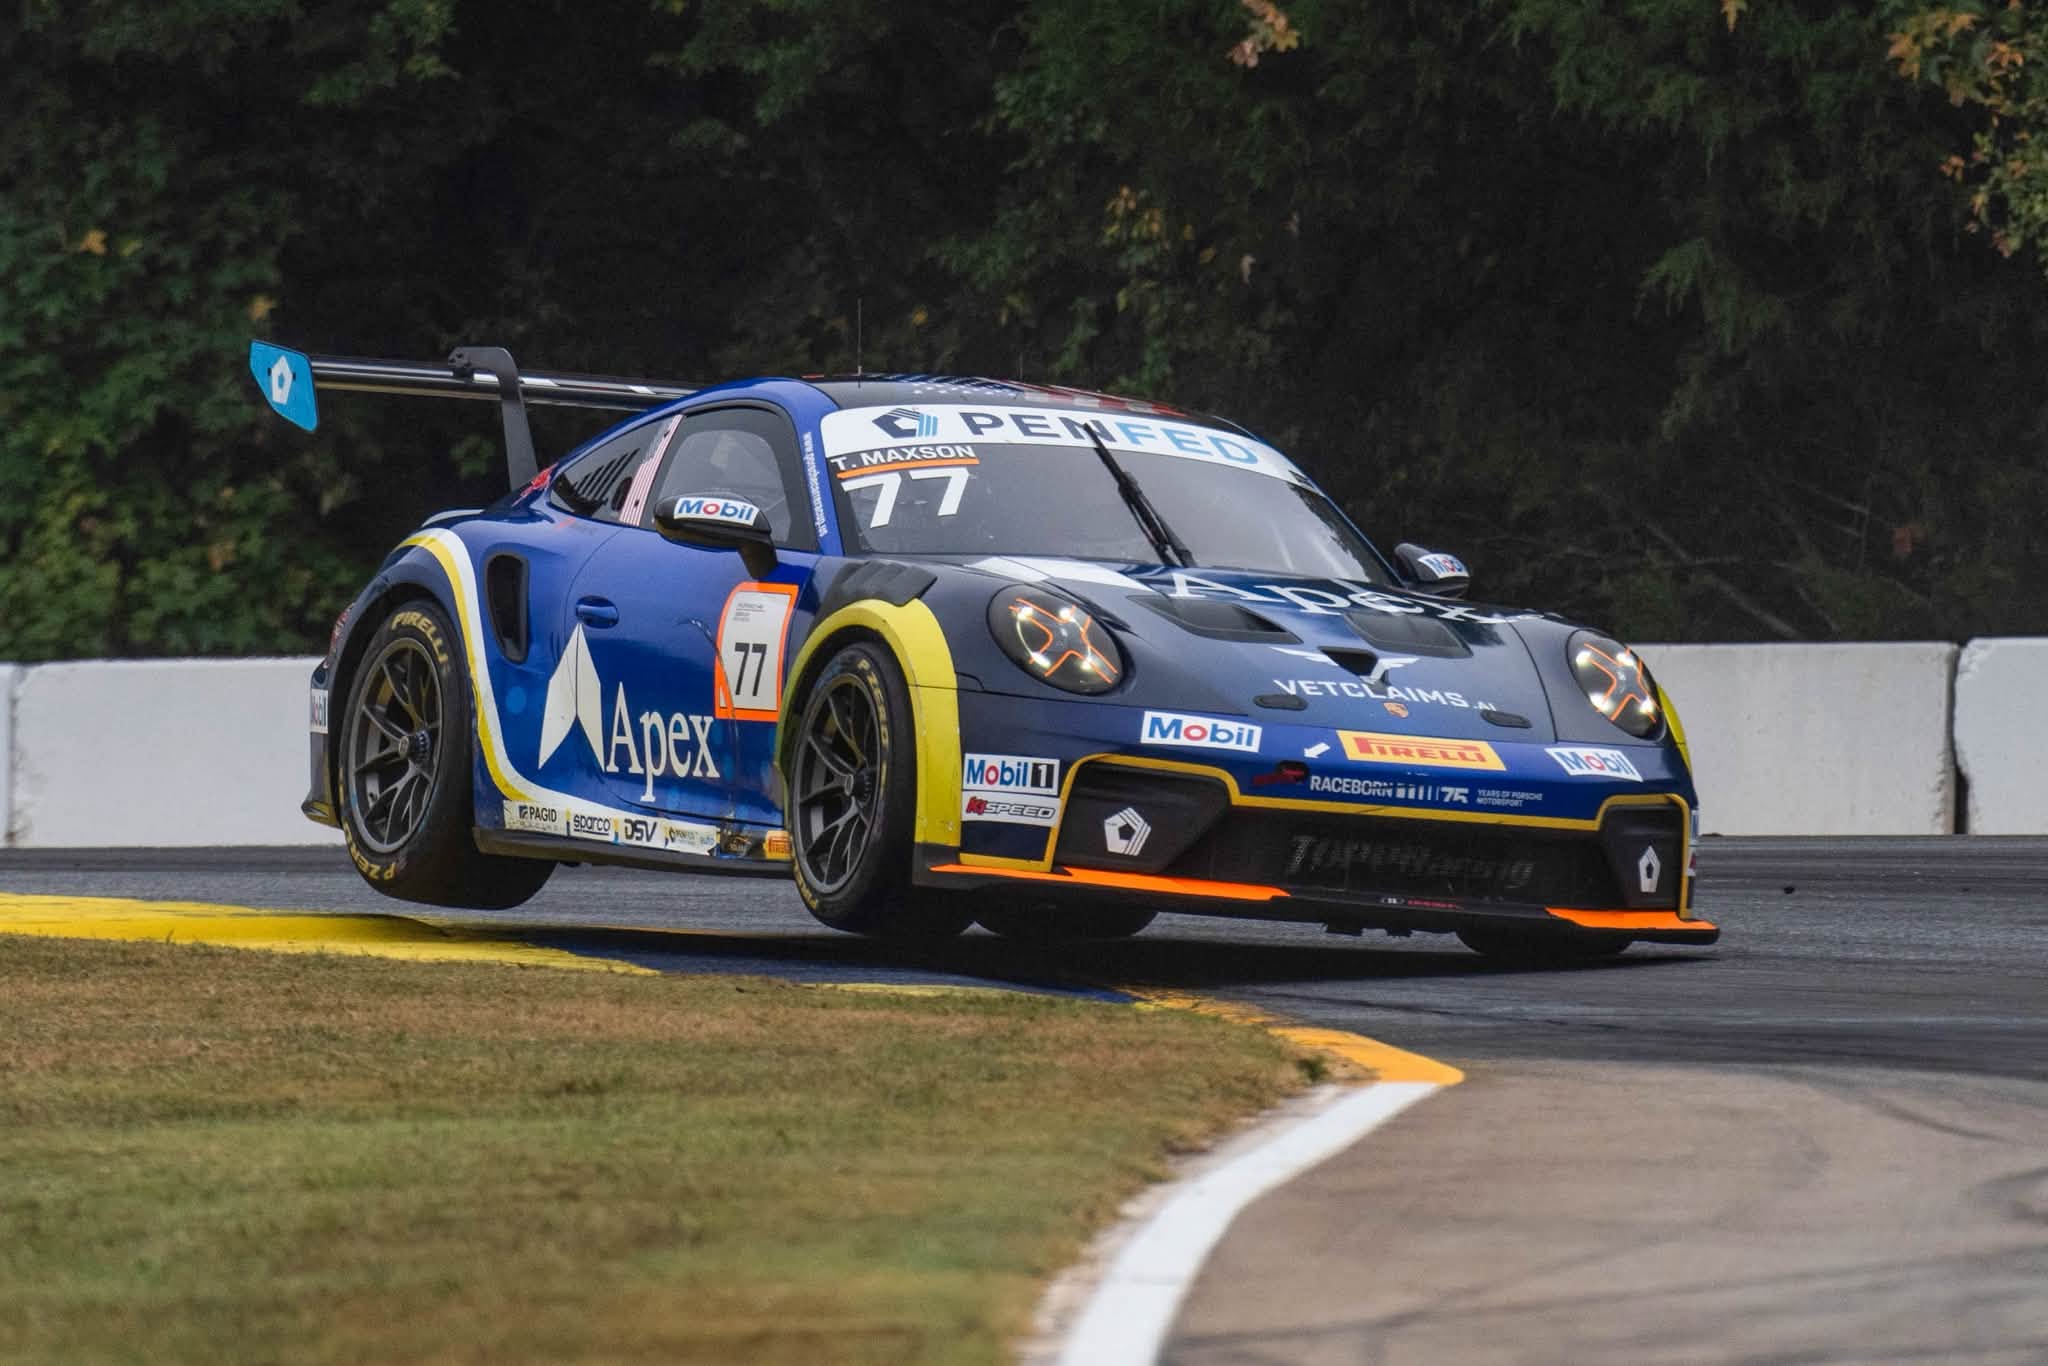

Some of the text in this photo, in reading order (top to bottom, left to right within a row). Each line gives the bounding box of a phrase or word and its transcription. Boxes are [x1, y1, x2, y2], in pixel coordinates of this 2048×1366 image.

[958, 410, 1259, 465] PENFED
[830, 445, 977, 471] T. MAXSON
[677, 499, 754, 521] Mobil
[840, 466, 970, 528] 77
[391, 611, 448, 664] PIRELLI
[734, 643, 767, 697] 77
[605, 681, 720, 802] Apex
[1148, 717, 1256, 747] Mobil
[1353, 737, 1488, 763] PIRELLI
[1553, 747, 1635, 776] Mobil
[966, 759, 1028, 787] Mobil
[1309, 775, 1394, 798] RACEBORN
[529, 806, 557, 822] PAGID
[573, 814, 611, 833] sparco
[624, 818, 657, 843] DSV
